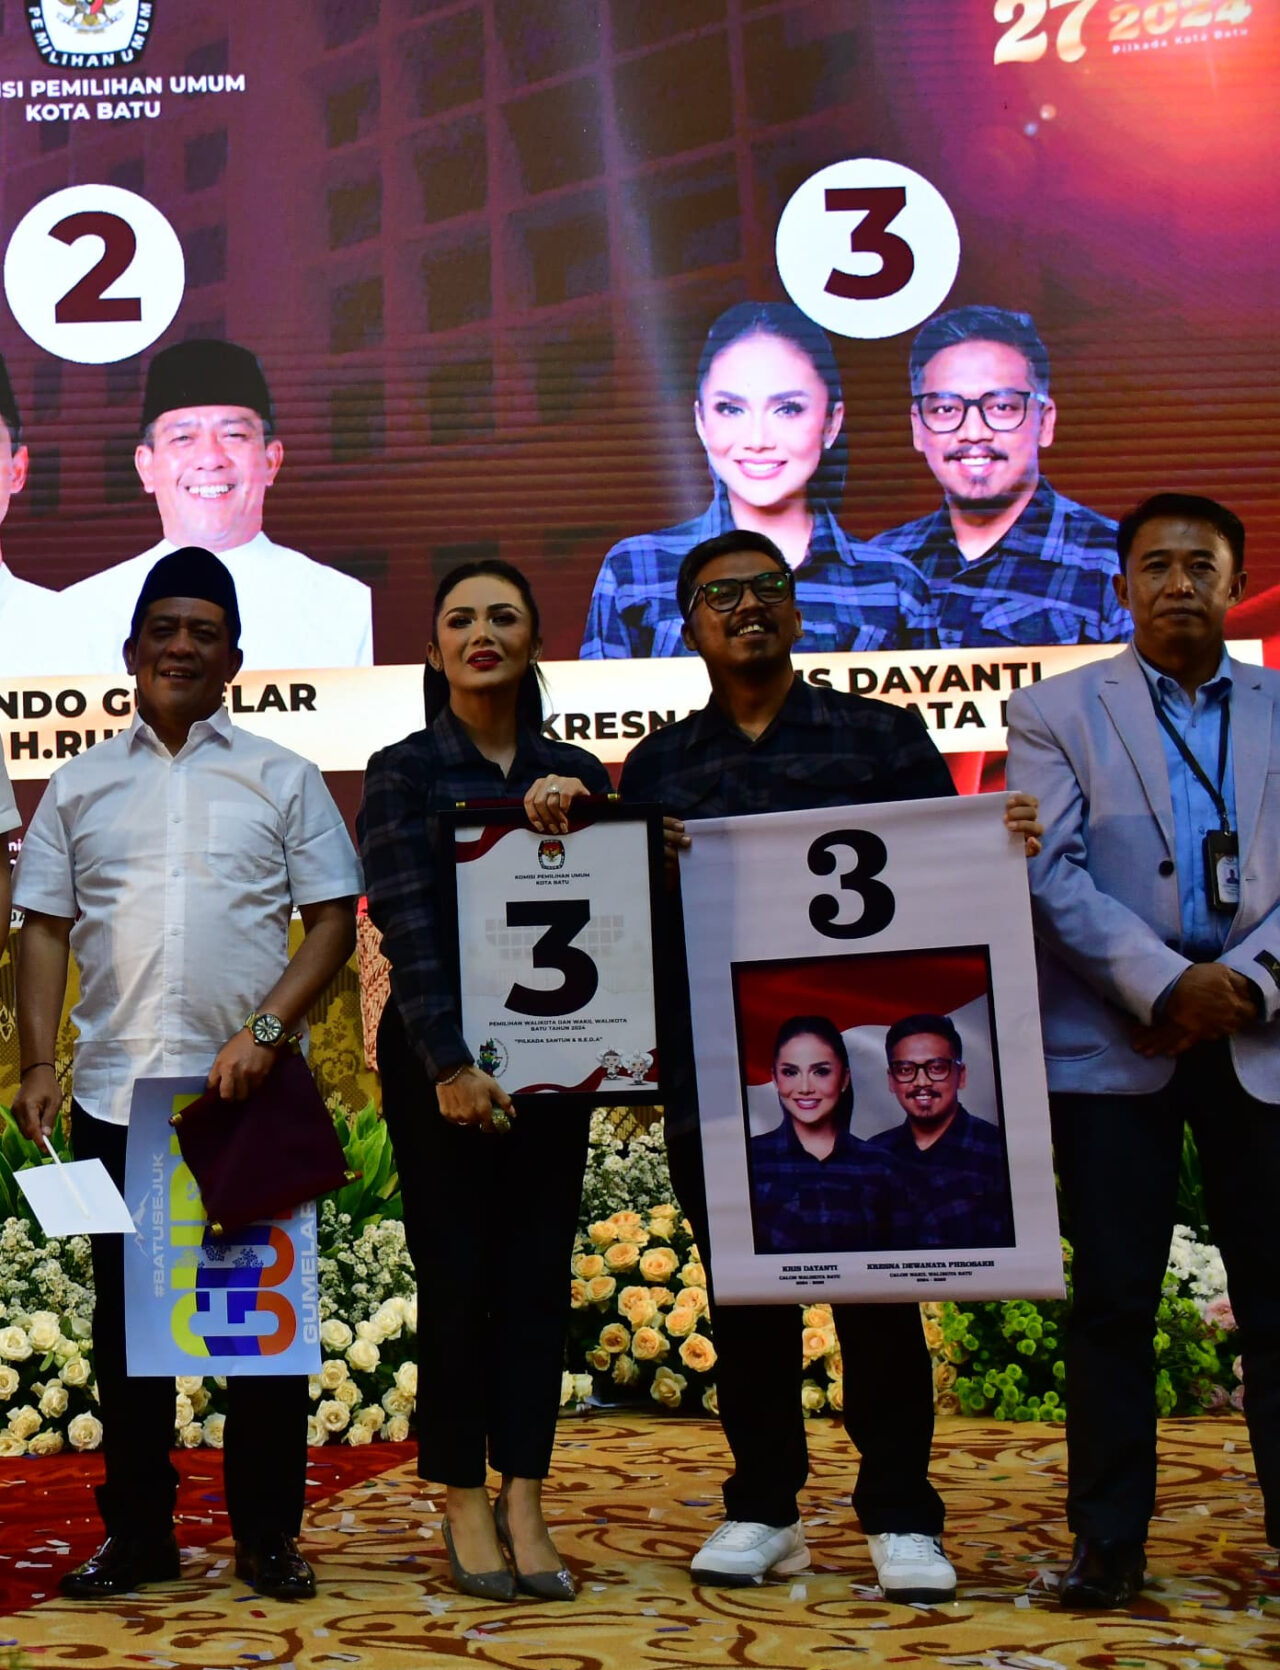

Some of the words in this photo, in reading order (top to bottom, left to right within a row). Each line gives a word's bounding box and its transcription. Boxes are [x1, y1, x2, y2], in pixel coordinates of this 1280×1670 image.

[28, 6, 115, 67] PEMILIHAN
[121, 2, 152, 62] UMUM
[994, 0, 1099, 64] 27
[1108, 0, 1252, 41] 2024
[25, 103, 90, 122] KOTA
[97, 100, 161, 120] BATU
[30, 77, 162, 98] PEMILIHAN
[169, 74, 245, 93] UMUM
[48, 211, 142, 324] 2
[824, 186, 915, 300] 3
[848, 662, 1042, 694] DAYANTI
[542, 709, 690, 741] KRESN
[807, 829, 896, 940] 3
[504, 899, 599, 1017] 3
[151, 1152, 166, 1298] #BATUSEJUK
[803, 1264, 838, 1272] DAYANTI
